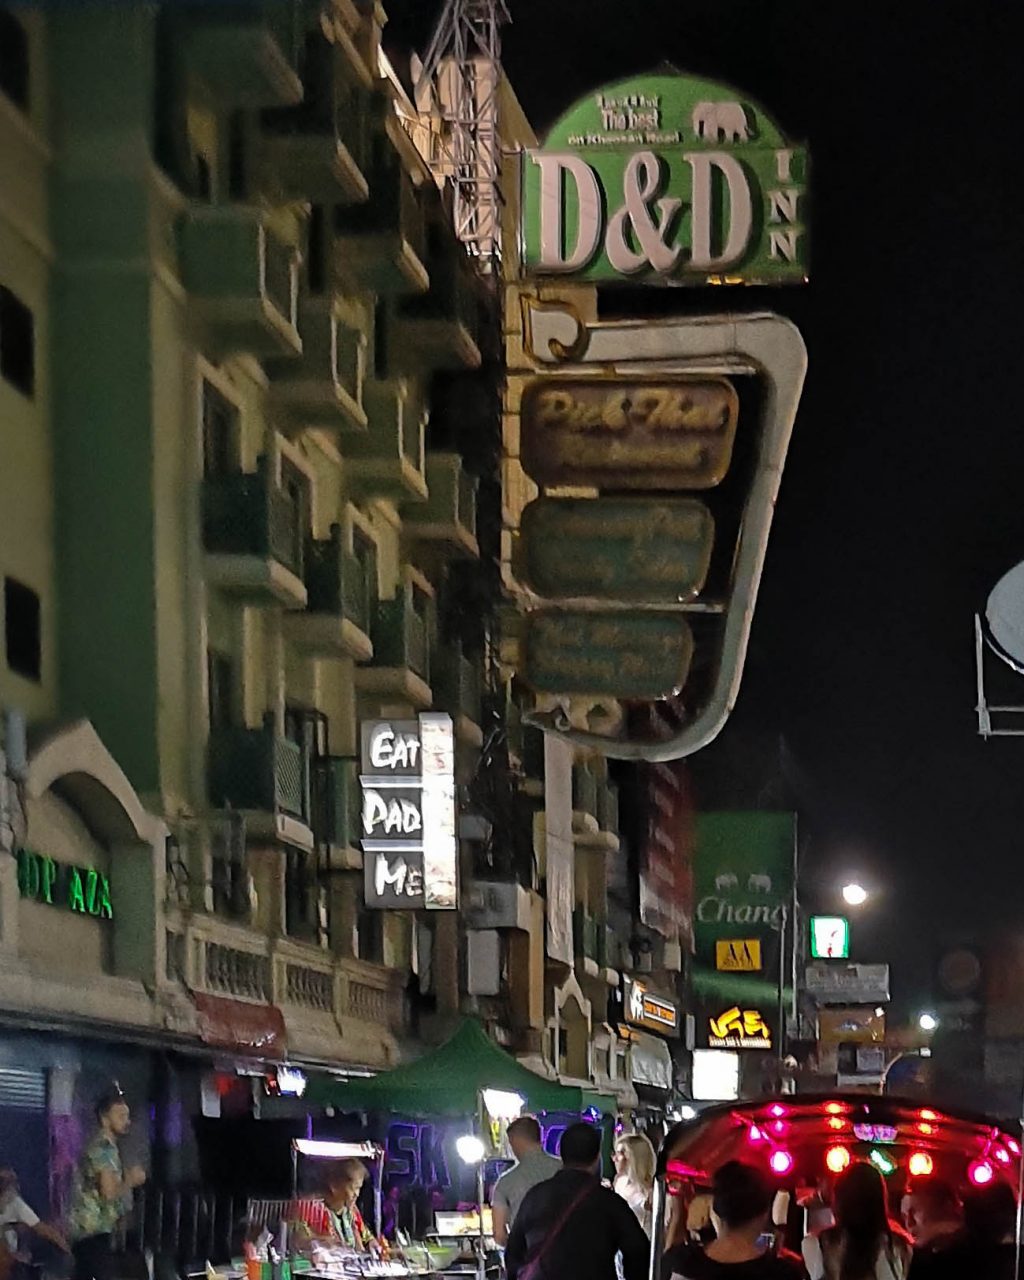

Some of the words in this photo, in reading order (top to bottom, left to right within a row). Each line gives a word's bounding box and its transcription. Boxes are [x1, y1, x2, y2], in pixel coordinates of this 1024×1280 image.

[532, 150, 753, 275] D&D
[767, 148, 801, 262] INN
[697, 895, 787, 932] Chang
